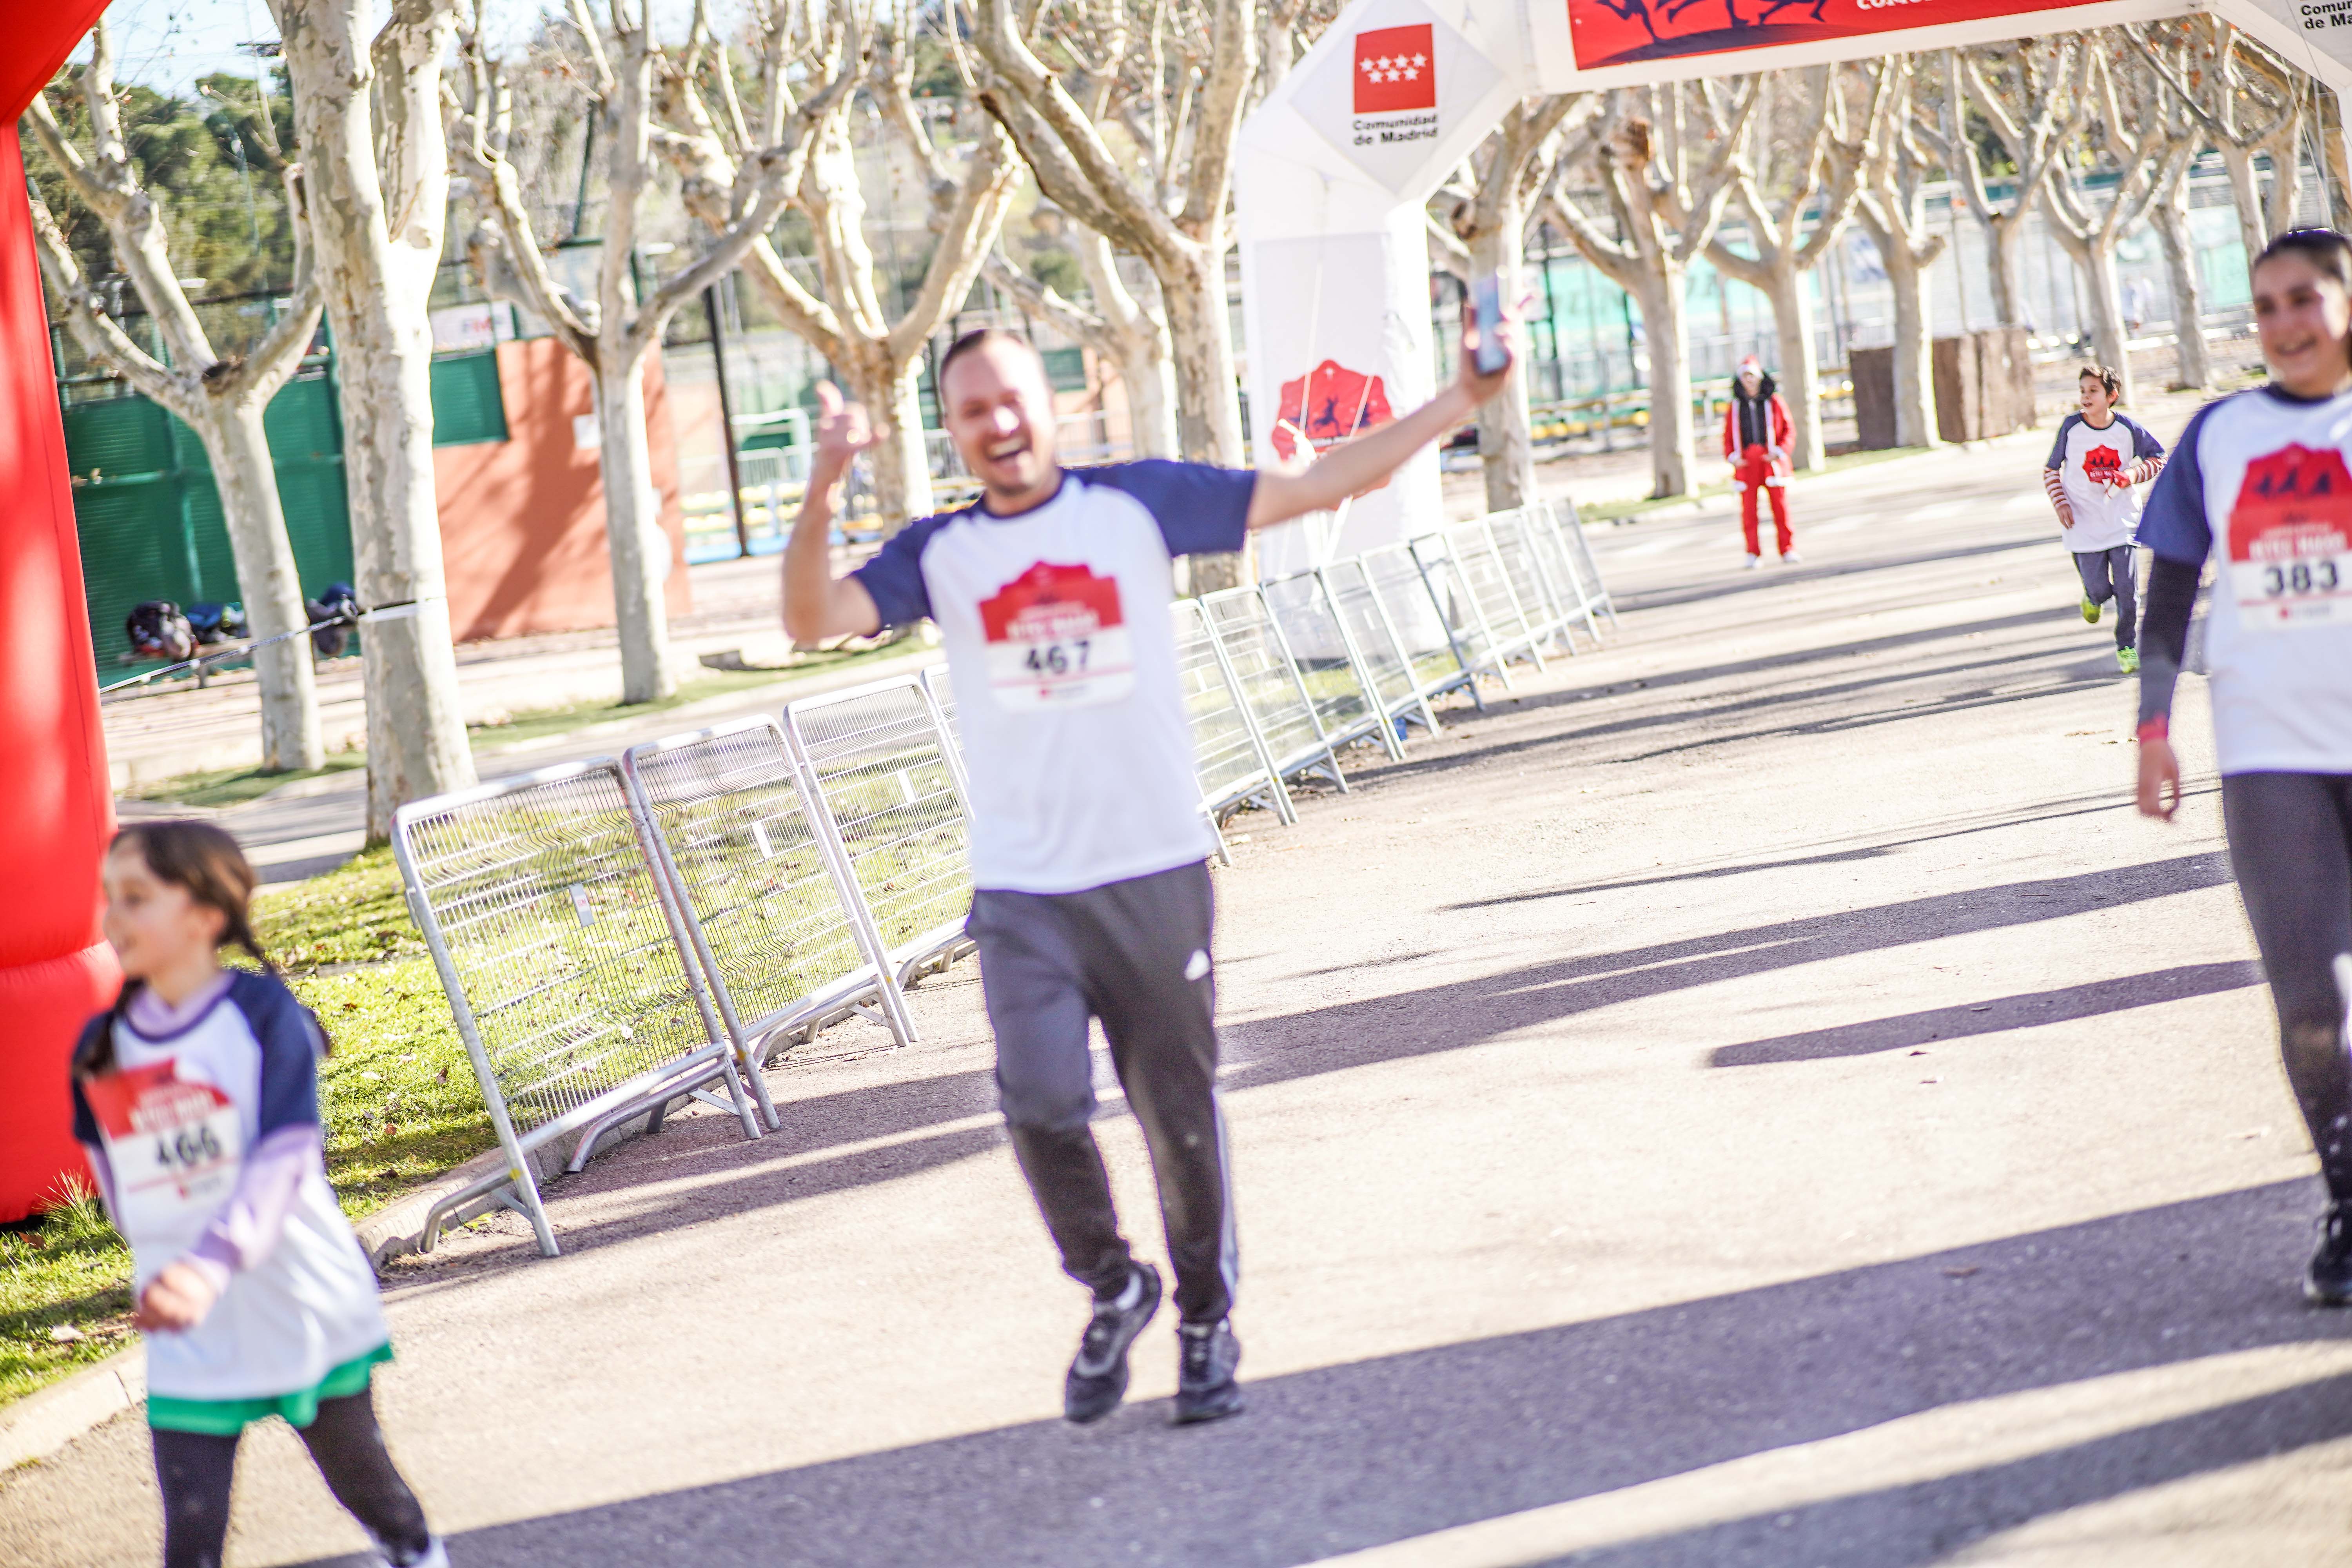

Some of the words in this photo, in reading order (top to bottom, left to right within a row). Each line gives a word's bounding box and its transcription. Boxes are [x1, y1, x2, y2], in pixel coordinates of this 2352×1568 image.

[2304, 17, 2325, 29] de
[1353, 113, 1438, 131] Comunidad
[1354, 134, 1373, 145] de
[1381, 127, 1438, 143] Madrid
[2265, 560, 2338, 598] 383
[1025, 639, 1089, 676] 467
[157, 1124, 221, 1167] 466
